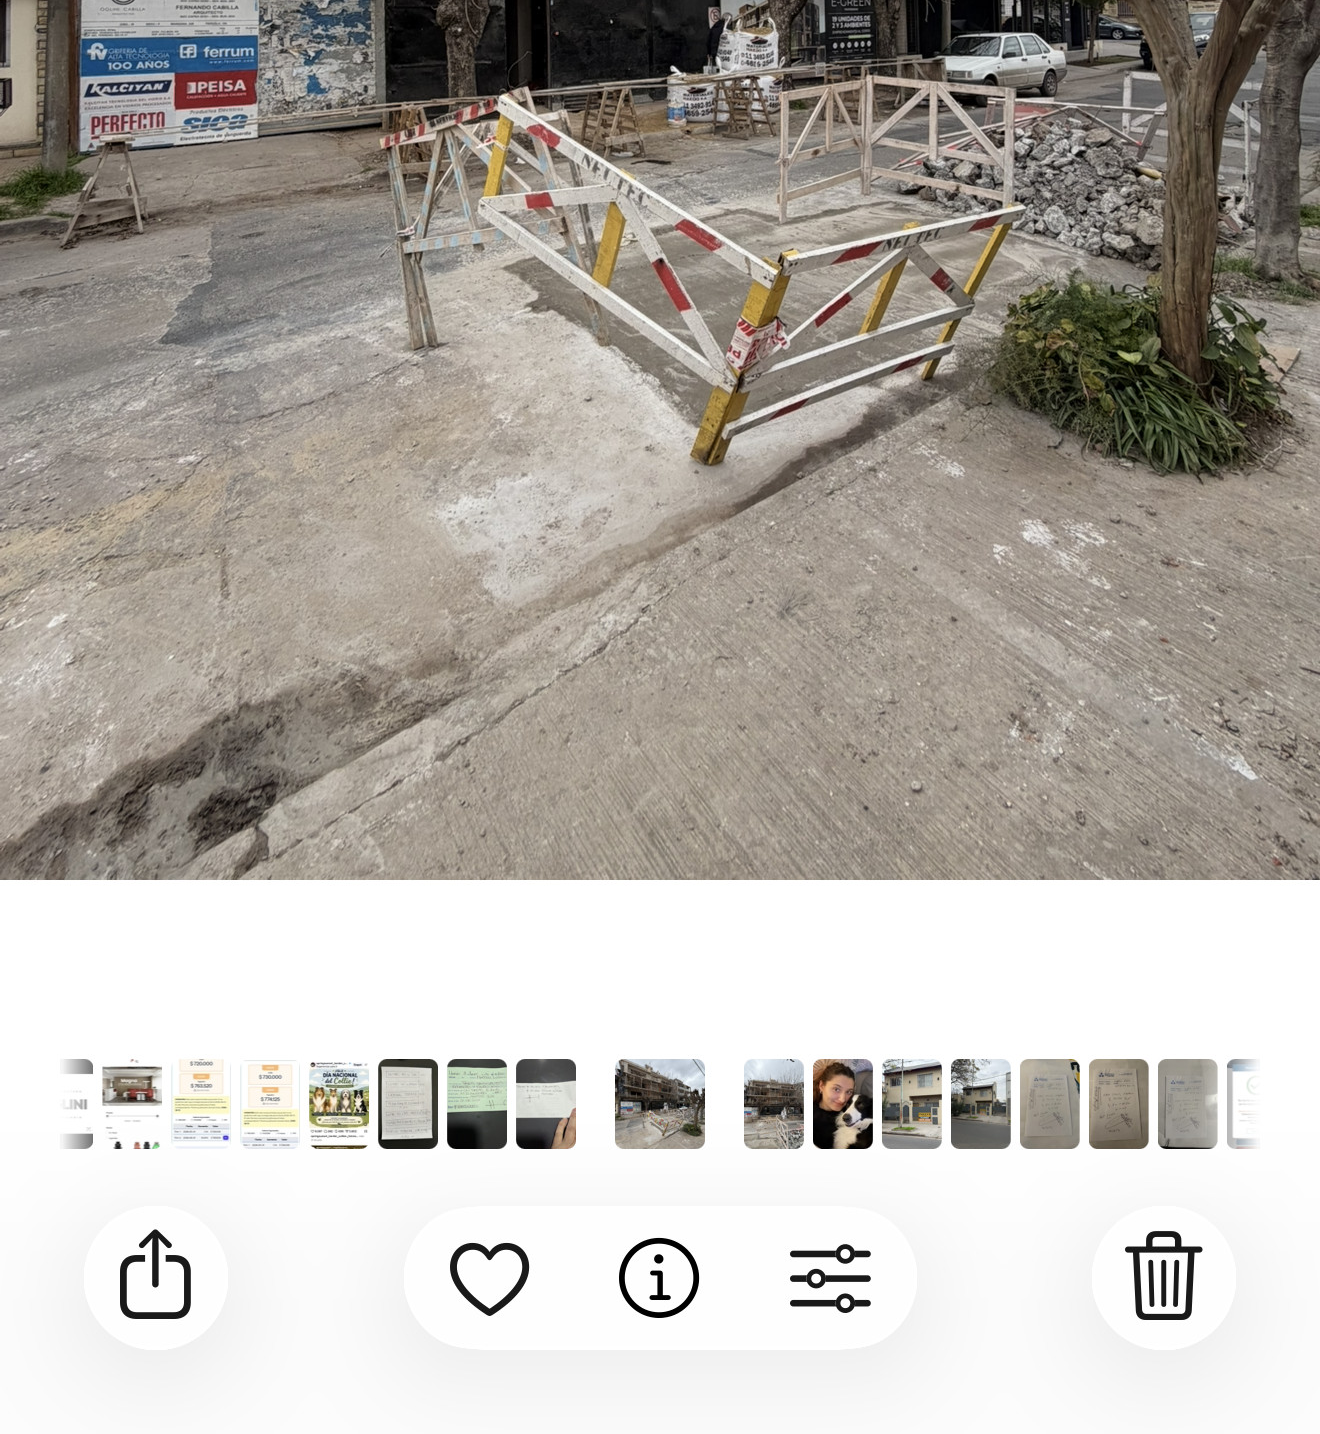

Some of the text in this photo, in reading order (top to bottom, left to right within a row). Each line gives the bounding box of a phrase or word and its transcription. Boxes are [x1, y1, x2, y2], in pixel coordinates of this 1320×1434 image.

[203, 46, 254, 58] ferrum
[108, 60, 170, 70] 100 AÑOS
[90, 83, 164, 96] KALCIYAN
[198, 79, 247, 93] PEISA
[91, 111, 165, 135] PERFECTO
